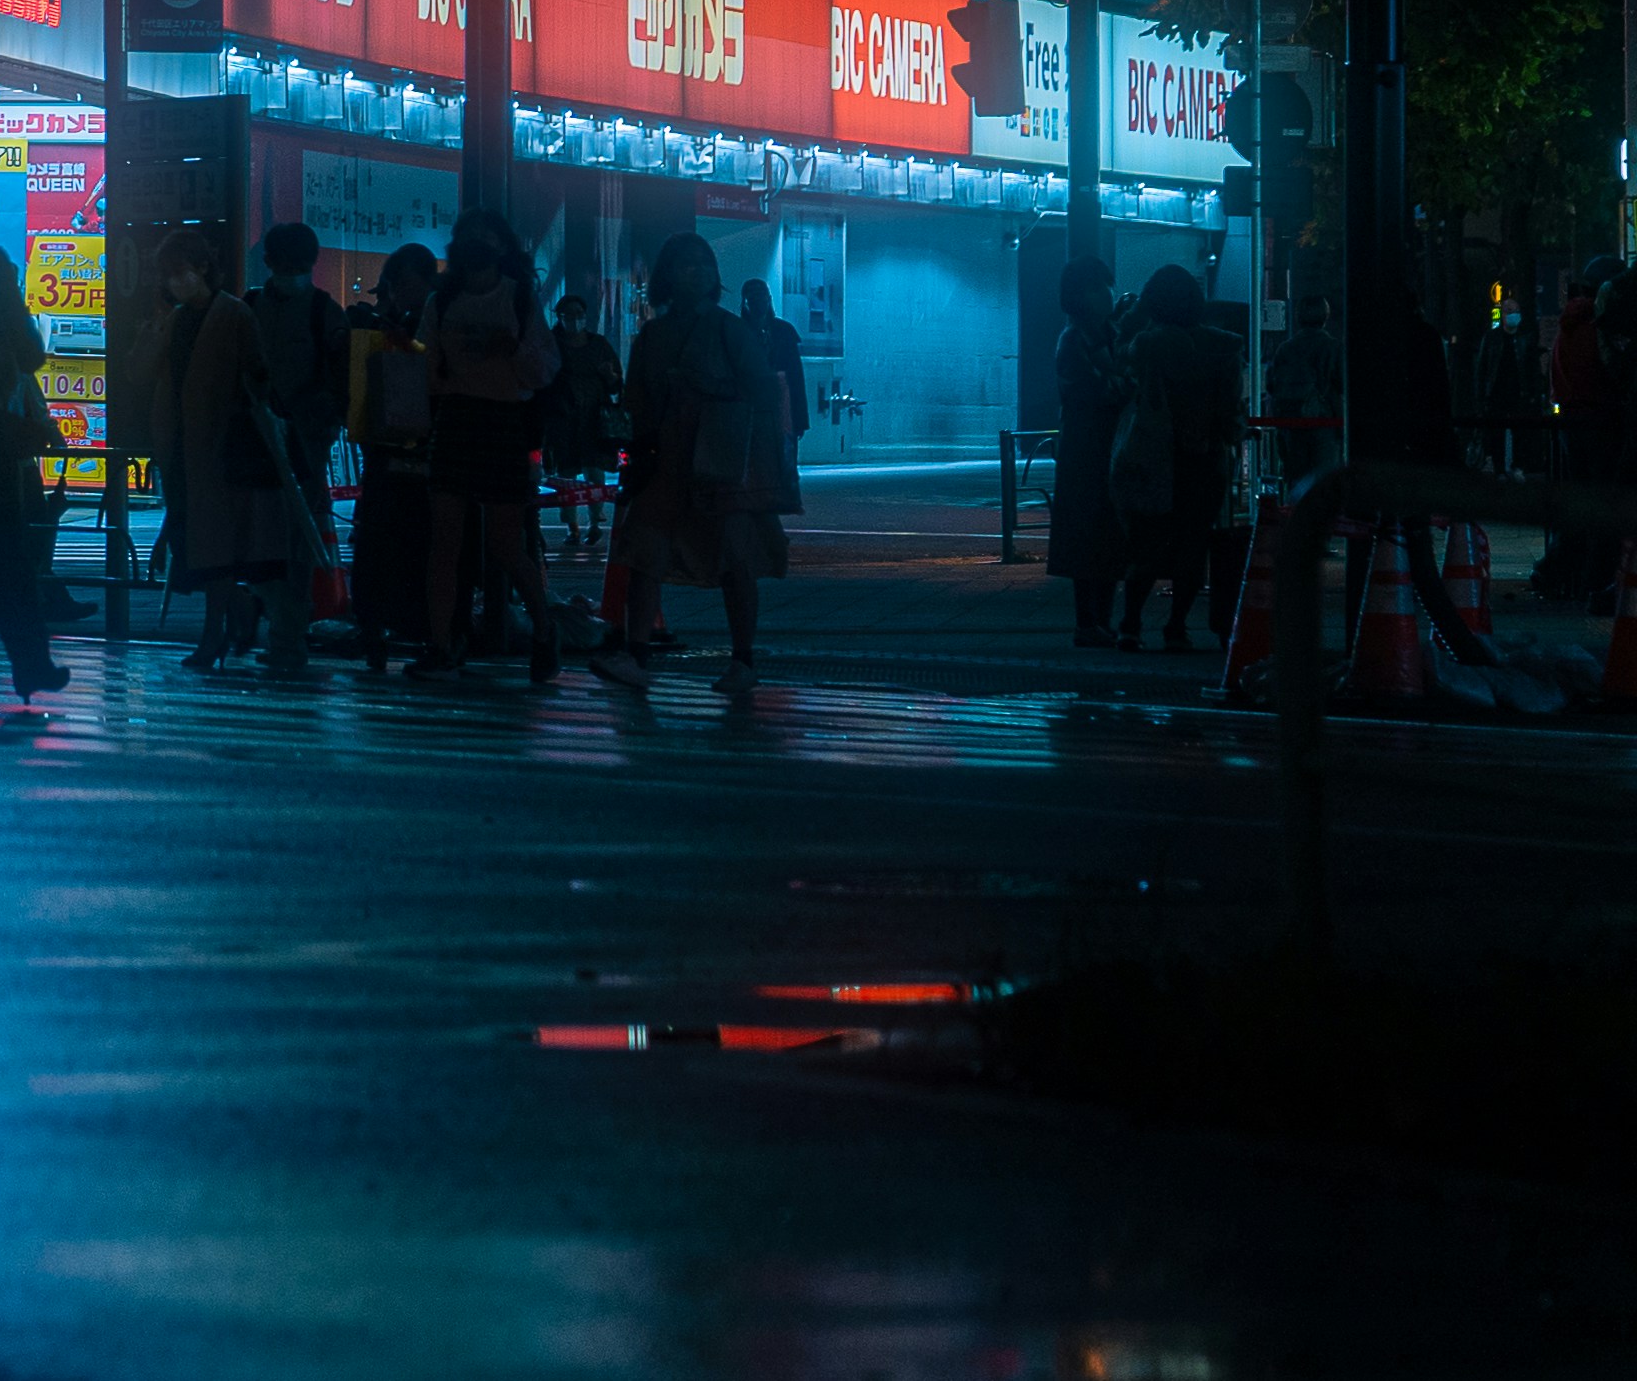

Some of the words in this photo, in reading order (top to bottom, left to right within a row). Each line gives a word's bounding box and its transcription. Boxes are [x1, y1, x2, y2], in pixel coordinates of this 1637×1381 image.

[831, 6, 865, 95] BIC
[868, 12, 947, 106] CAMERA
[1027, 22, 1060, 92] Free
[1128, 58, 1158, 135] BIC
[1163, 64, 1238, 143] CAMER
[27, 177, 85, 193] QUEEN
